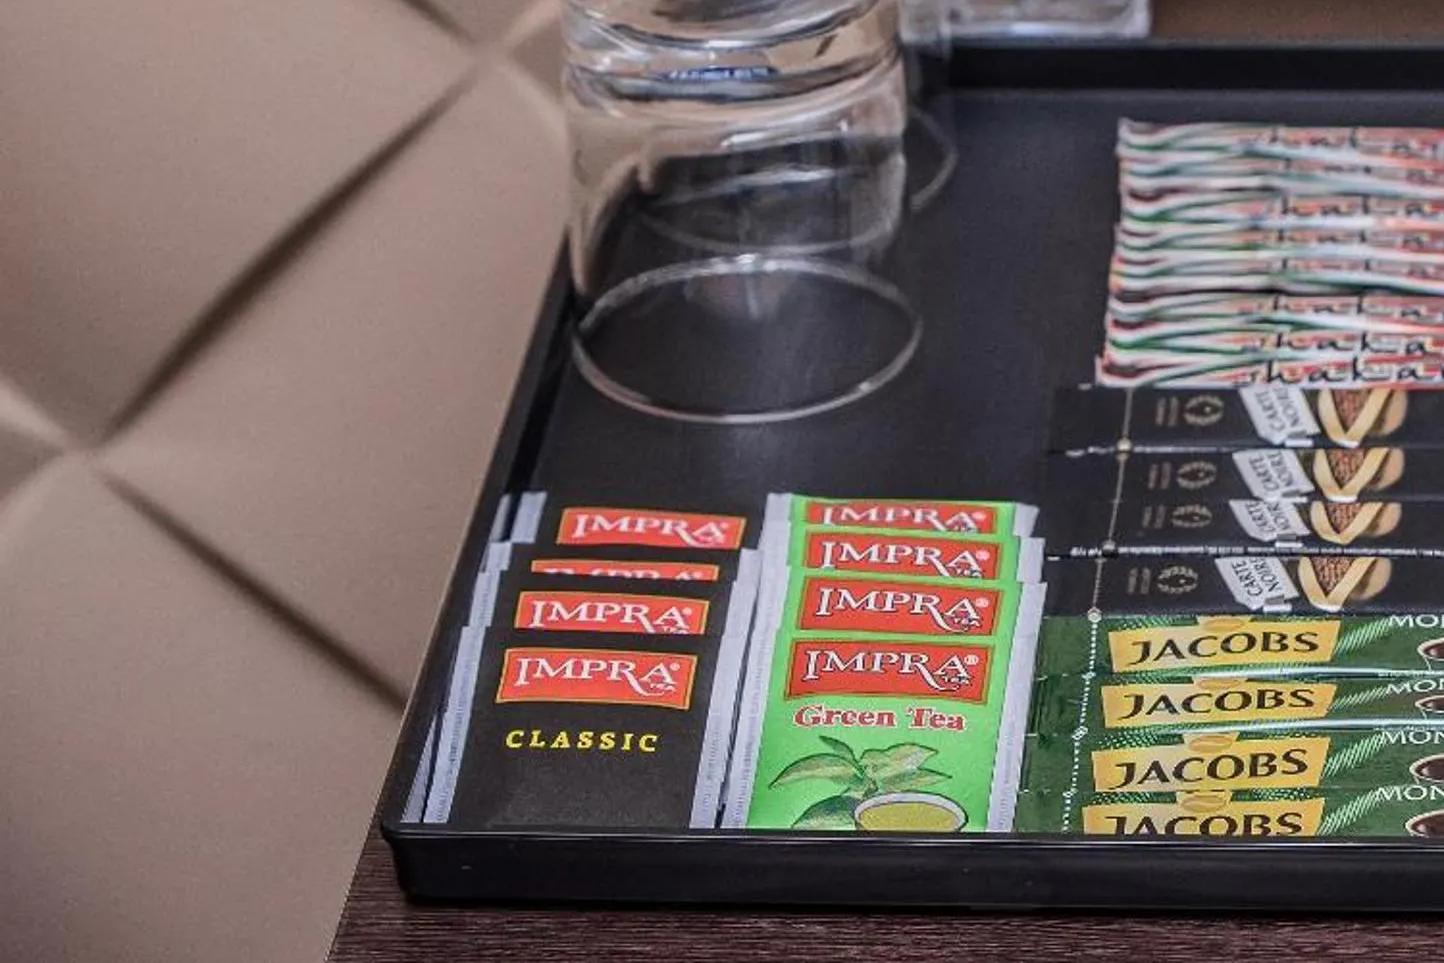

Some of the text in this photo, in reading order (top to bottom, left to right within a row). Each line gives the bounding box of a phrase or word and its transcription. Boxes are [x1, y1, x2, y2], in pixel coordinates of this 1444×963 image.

[572, 514, 725, 548] IMPRA
[821, 507, 979, 534] IMPRA
[820, 540, 982, 577] IMPRA
[529, 600, 690, 634] IMPRA
[815, 587, 980, 633] IMPRA
[1128, 631, 1319, 666] JACOBS
[513, 657, 678, 697] IMPRA
[801, 650, 971, 692] IMPRA
[793, 703, 968, 732] Green Tea
[1117, 688, 1315, 721] JACOBS
[505, 729, 658, 753] CLASSIC
[1108, 747, 1309, 791] JACOBS
[1104, 811, 1303, 836] JACOBS
